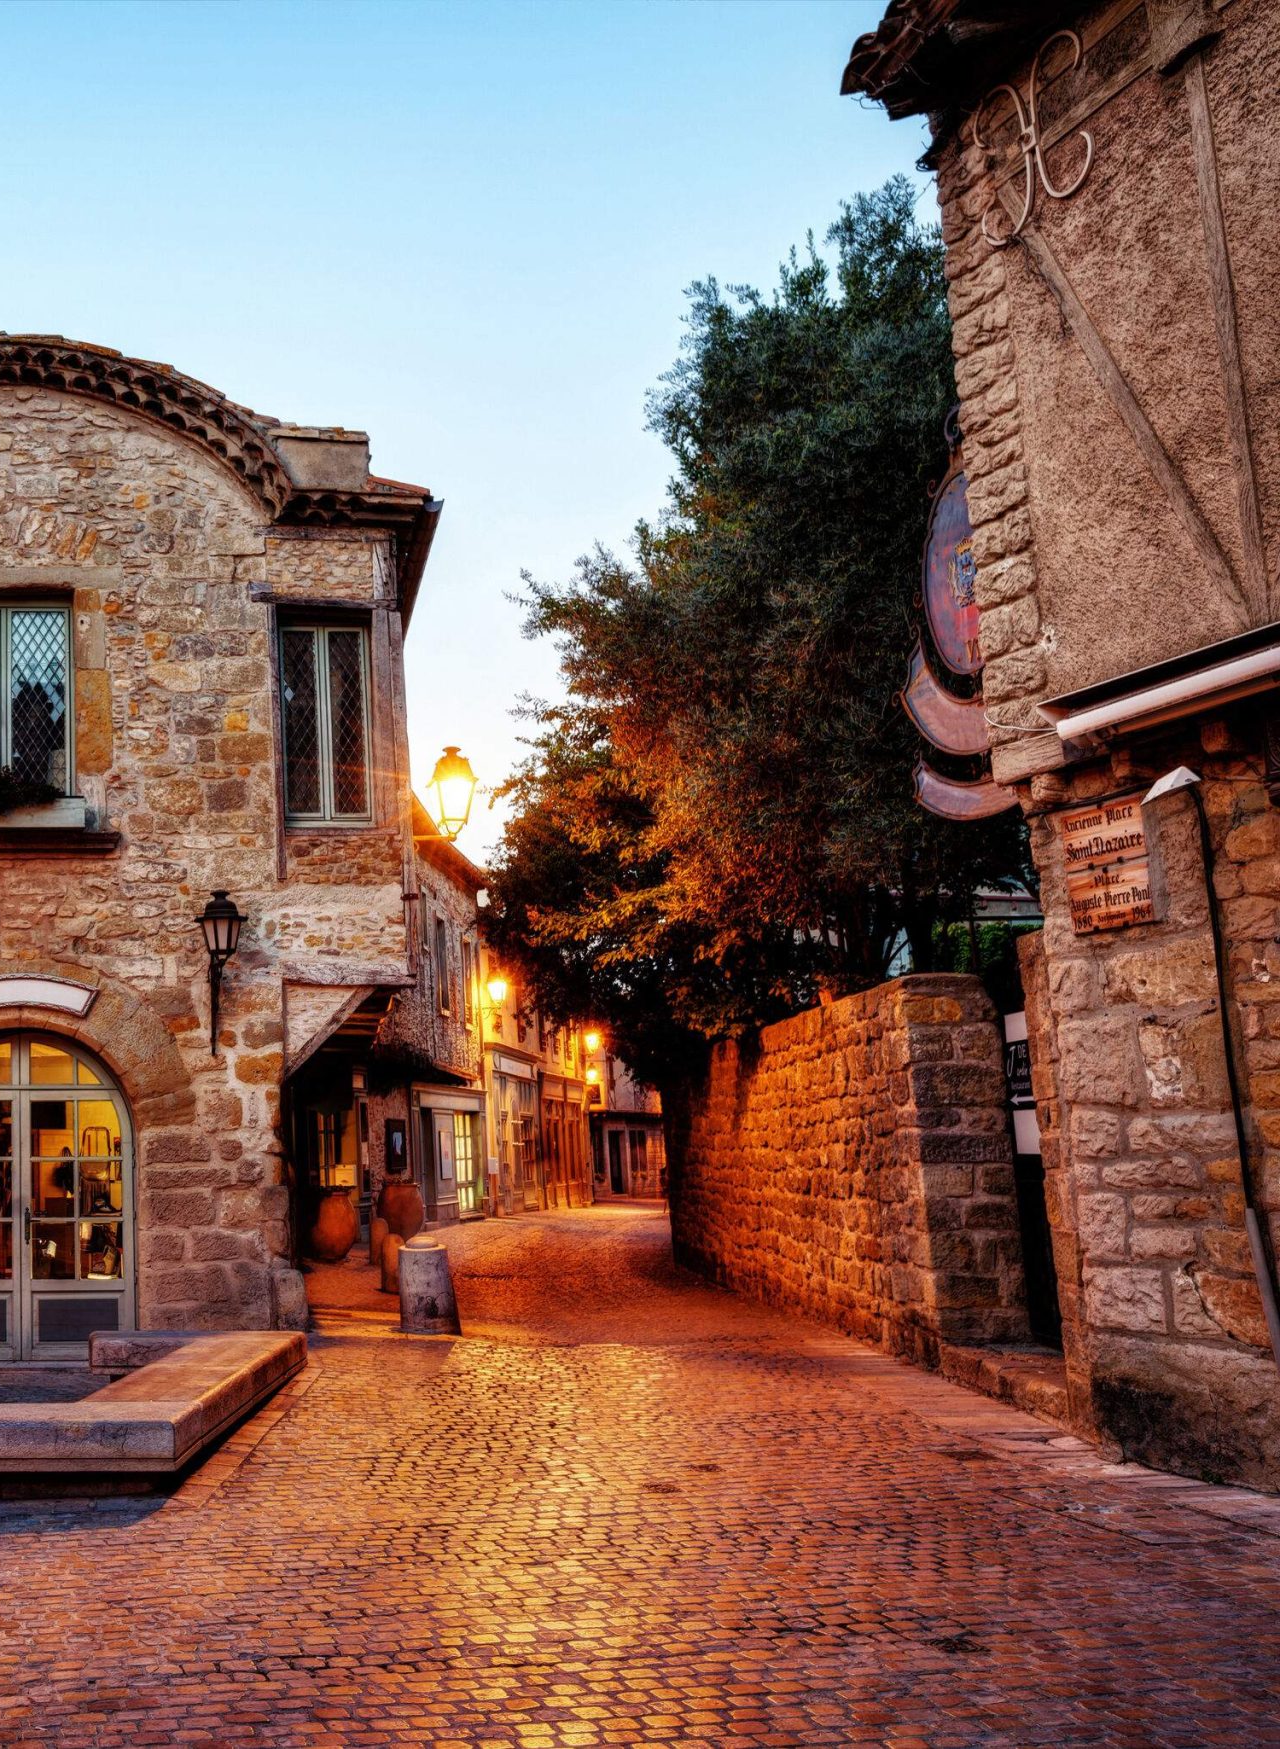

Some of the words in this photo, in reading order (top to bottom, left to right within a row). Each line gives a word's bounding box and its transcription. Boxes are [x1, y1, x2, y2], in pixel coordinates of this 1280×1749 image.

[1064, 814, 1102, 833] Ancienne
[1105, 805, 1133, 825] Place
[1066, 838, 1093, 863] Saint
[1093, 830, 1143, 856] Nazaire
[1071, 893, 1102, 915] Auguste
[1104, 890, 1131, 908] Pierre
[1074, 914, 1093, 931] 1880
